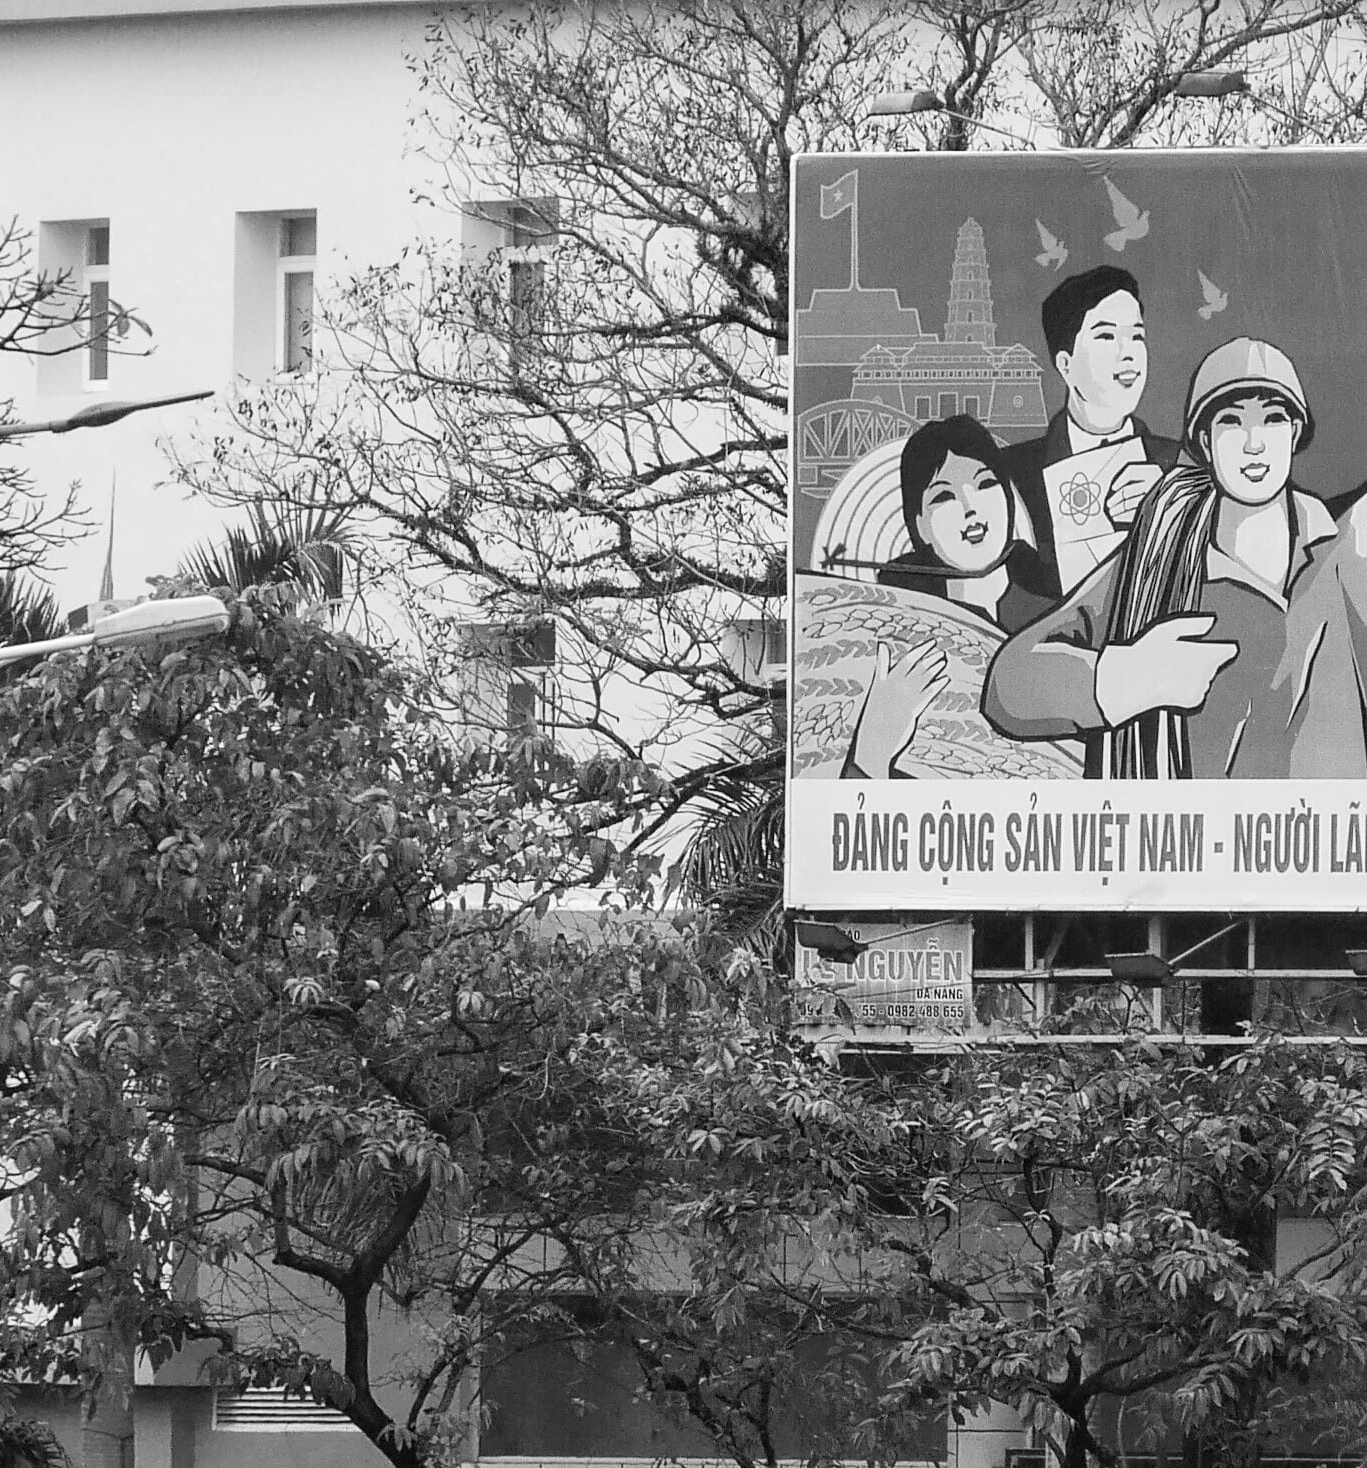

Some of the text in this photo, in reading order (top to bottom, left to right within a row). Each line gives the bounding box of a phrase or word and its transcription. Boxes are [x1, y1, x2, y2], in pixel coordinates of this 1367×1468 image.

[832, 791, 908, 873] ĐẢNG
[919, 799, 995, 886] CỘNG
[1004, 791, 1063, 873] SẢN
[1071, 799, 1130, 886] VIỆT
[1138, 812, 1204, 873] NAM
[1233, 797, 1320, 873] NGƯỜI
[845, 938, 963, 982] NGUYỄN
[888, 1004, 915, 1017] 0982
[943, 1004, 964, 1018] 655
